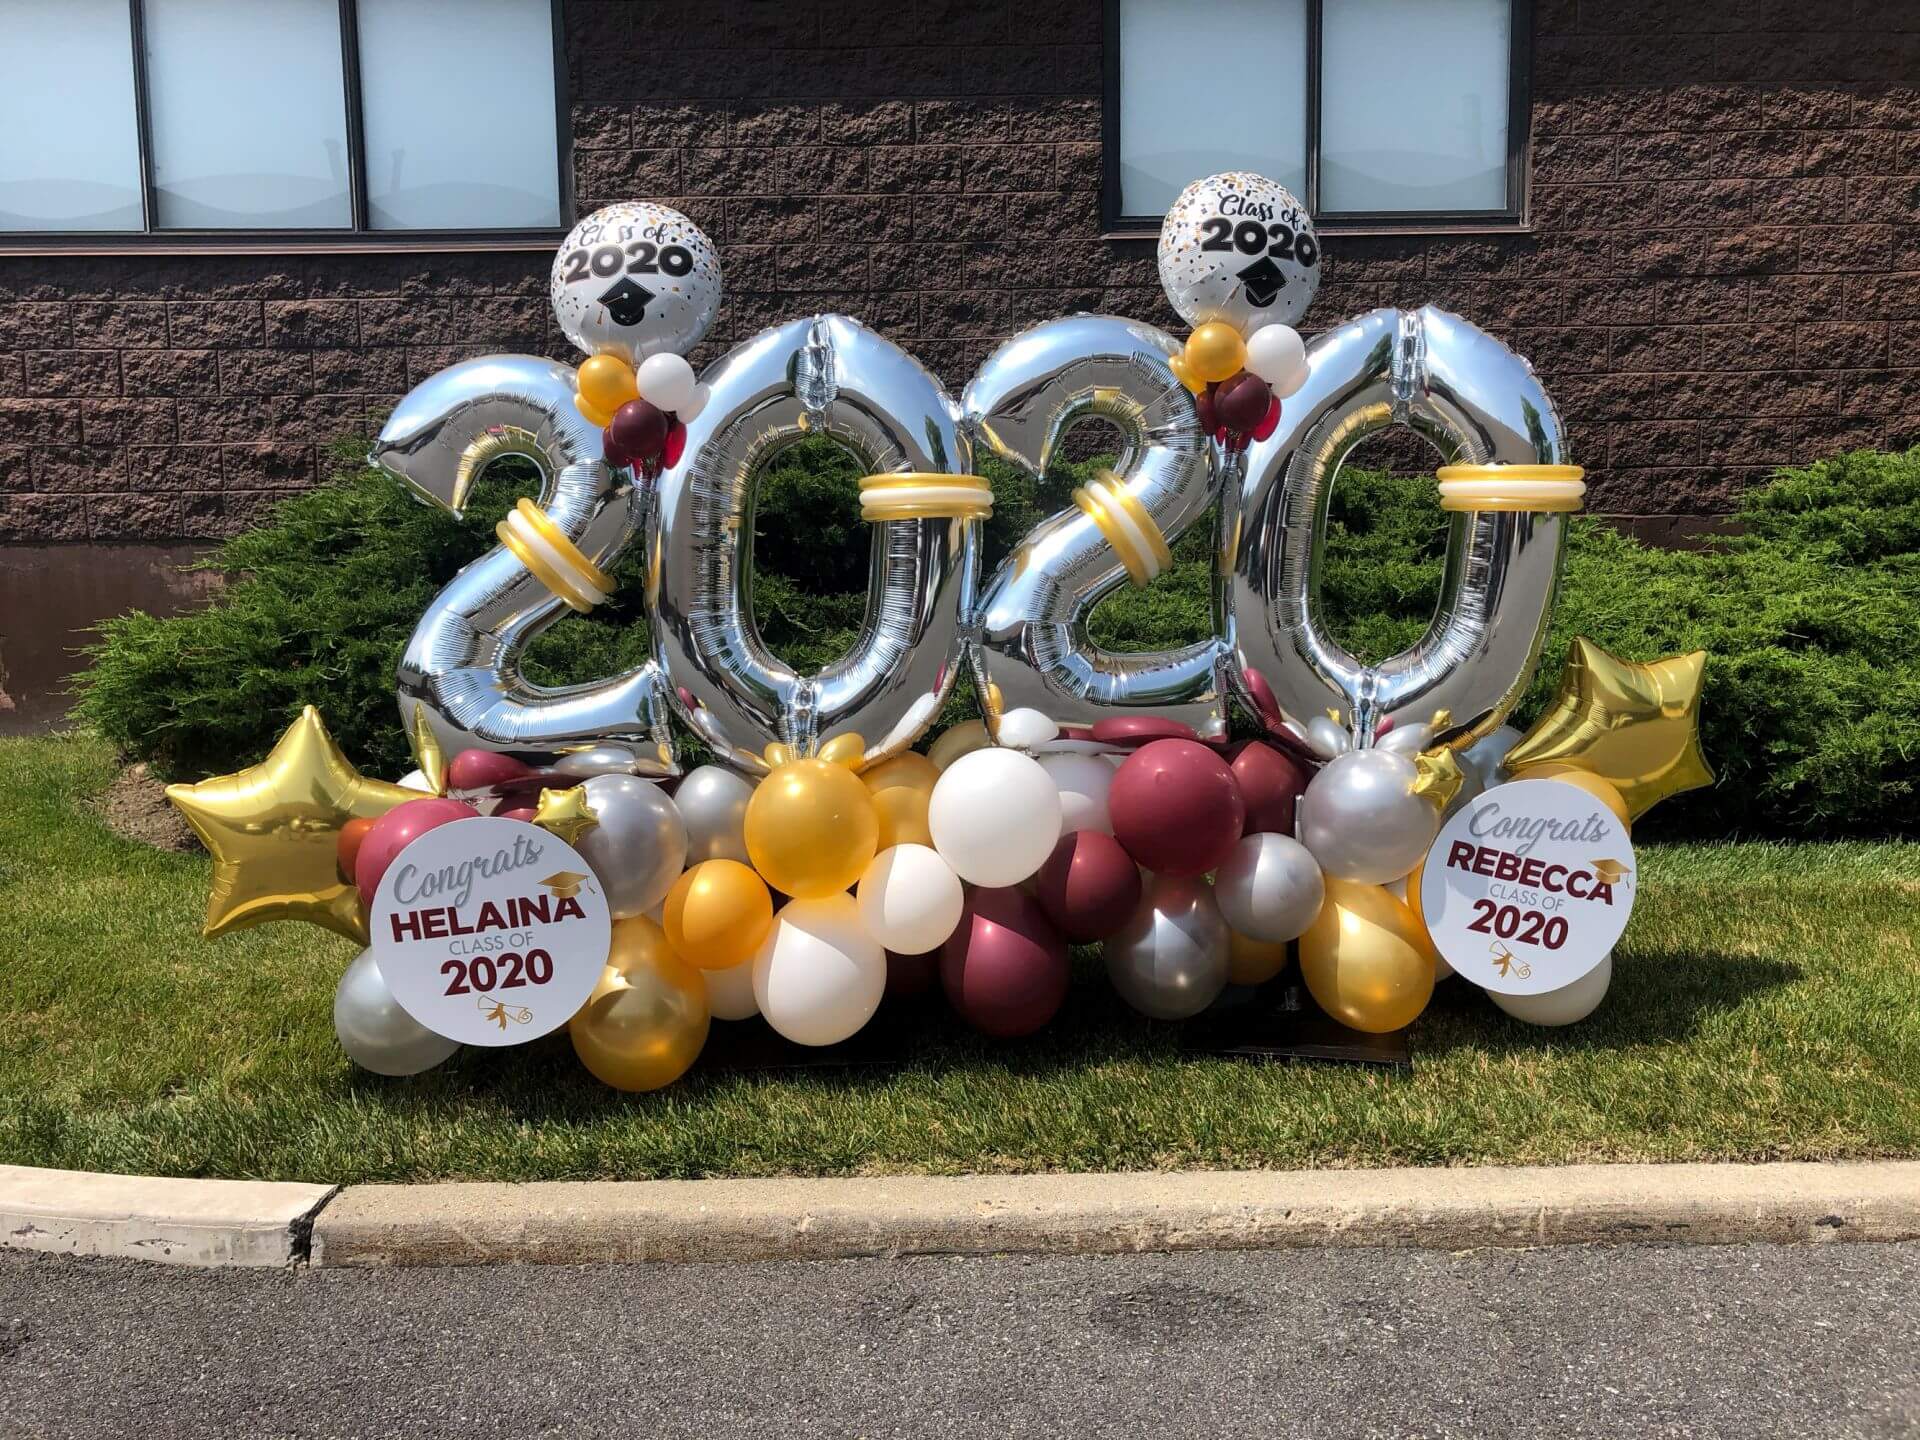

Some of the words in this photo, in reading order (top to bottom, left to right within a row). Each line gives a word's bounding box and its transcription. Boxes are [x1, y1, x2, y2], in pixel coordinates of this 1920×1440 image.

[579, 224, 635, 247] Clss
[643, 222, 669, 244] of
[1217, 191, 1275, 222] Class
[1281, 207, 1301, 231] of
[563, 241, 694, 285] 2020
[1201, 217, 1318, 268] 2020
[370, 306, 1569, 778] 2020
[1468, 802, 1611, 856] Congrats
[393, 833, 545, 908] Congrats
[1446, 839, 1614, 906] REBECCA
[390, 894, 587, 943] HELAINA
[1489, 883, 1538, 906] CLASS
[1541, 895, 1566, 912] OF
[448, 935, 504, 956] CLASS
[509, 931, 534, 948] OF
[1466, 898, 1569, 951] 2020
[440, 948, 554, 996] 2020
